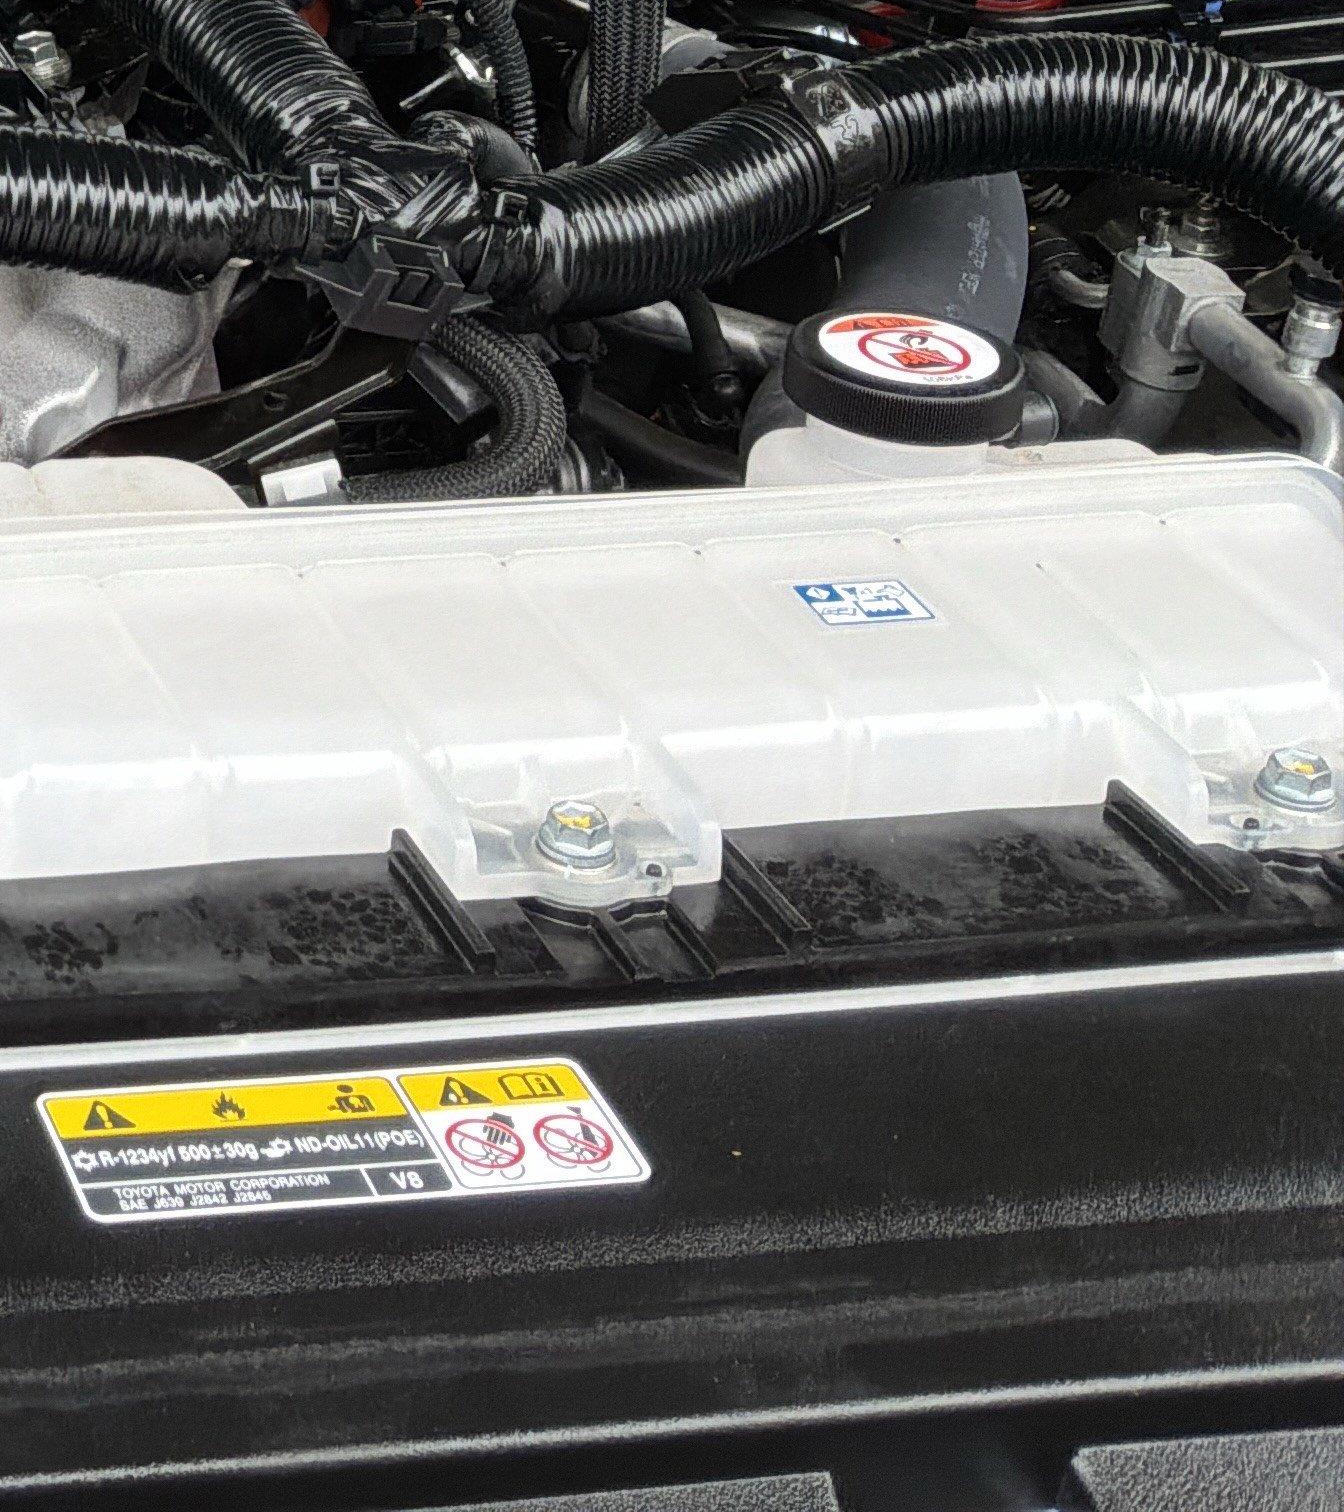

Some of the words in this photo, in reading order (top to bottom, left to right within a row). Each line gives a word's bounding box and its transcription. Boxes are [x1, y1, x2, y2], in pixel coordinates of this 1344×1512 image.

[97, 1144, 177, 1168] R-1234yf
[113, 1184, 171, 1200] TOYOTA
[174, 1180, 227, 1196] MOTOR
[229, 1173, 331, 1192] CORPORATION
[118, 1199, 149, 1212] SAE
[153, 1196, 185, 1210] J639
[189, 1193, 229, 1207] J2842
